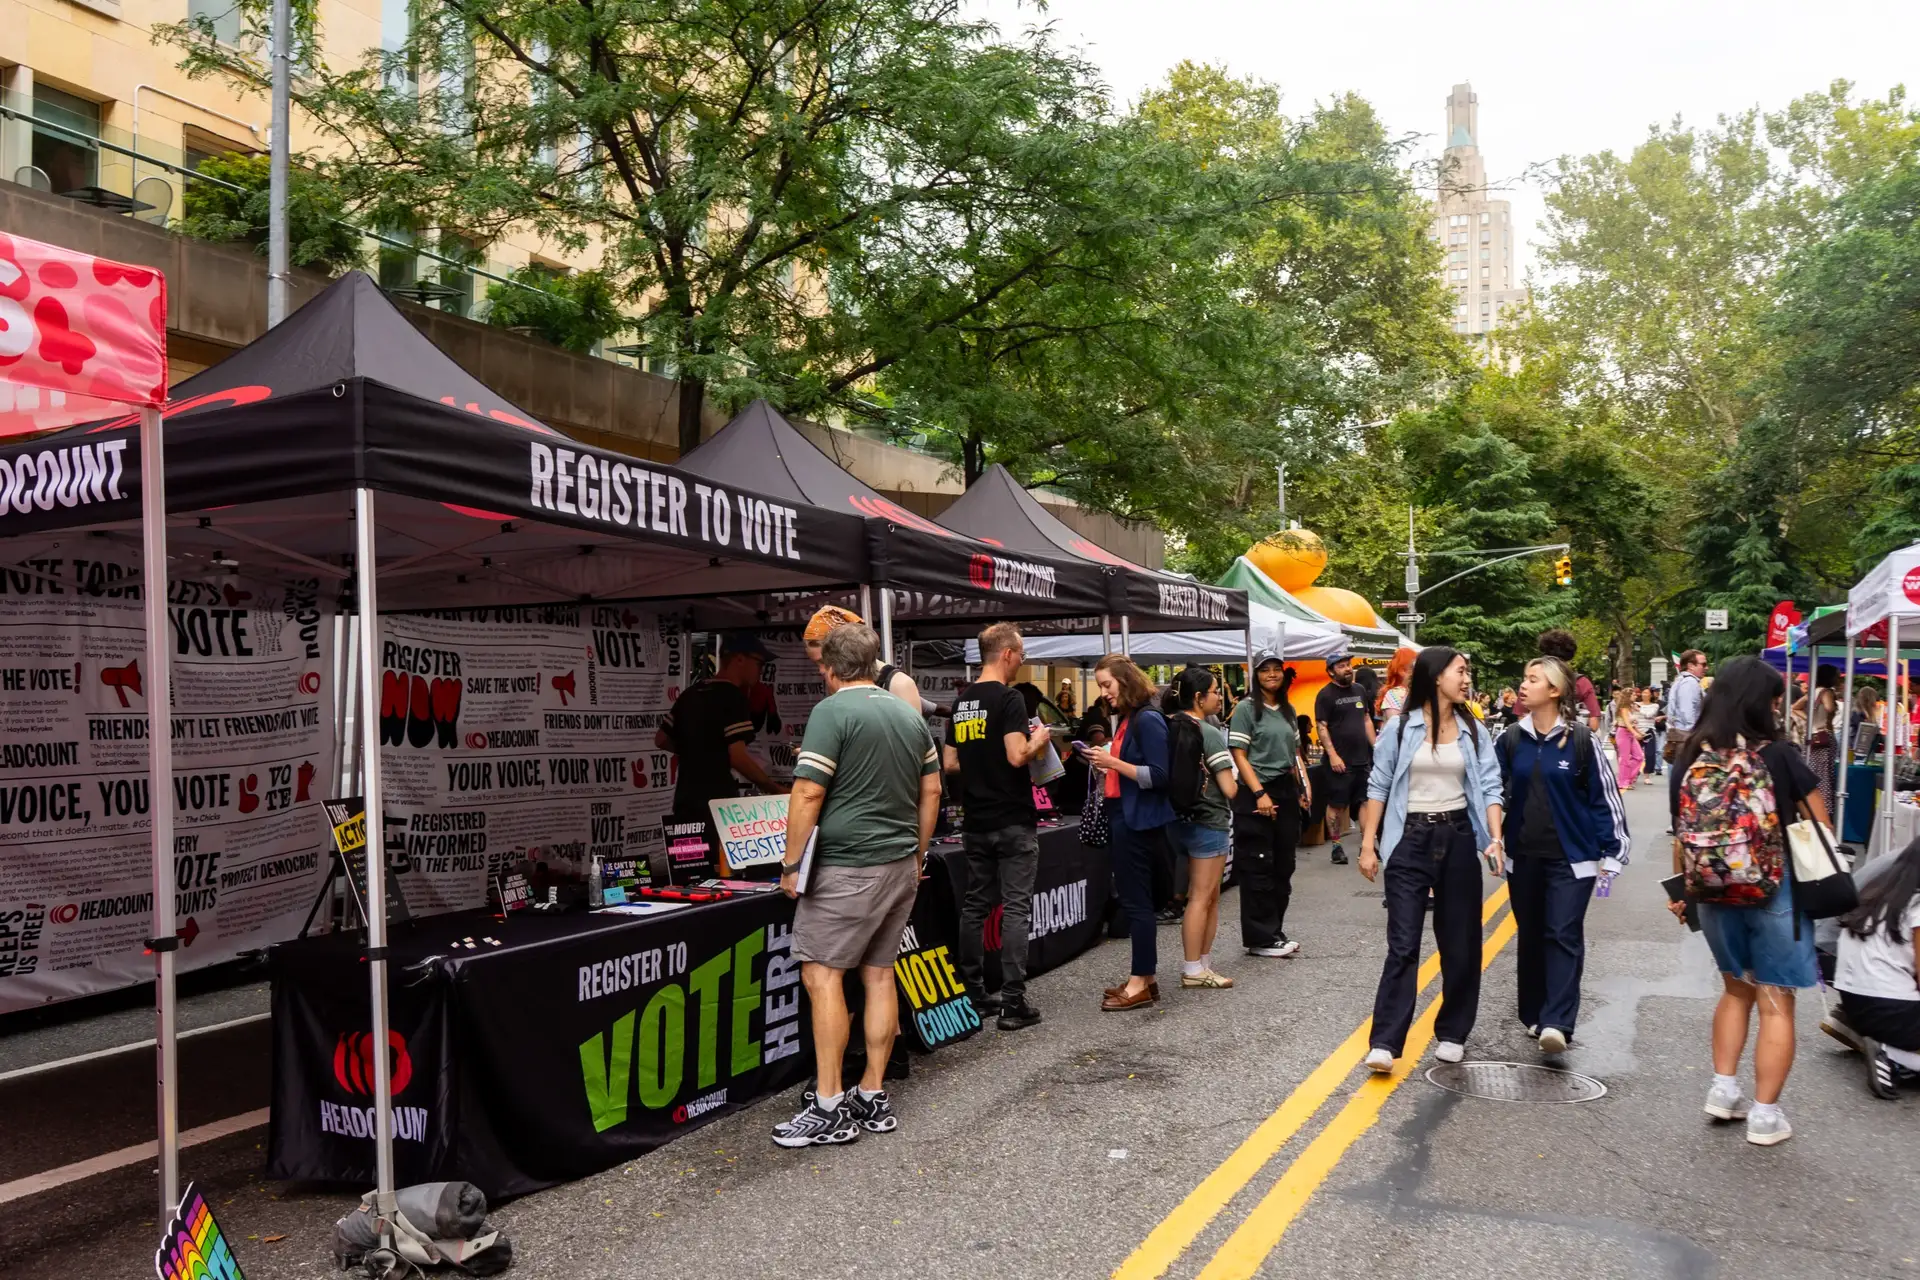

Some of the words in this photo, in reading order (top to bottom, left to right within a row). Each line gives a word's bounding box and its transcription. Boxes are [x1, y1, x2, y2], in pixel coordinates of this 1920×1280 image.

[531, 441, 688, 538] REGISTER
[695, 483, 730, 546] TO
[738, 494, 801, 560] VOTE
[993, 556, 1056, 599] HEADCOUNT
[168, 580, 221, 605] LET'S
[1158, 583, 1198, 617] REGISTER
[1199, 588, 1209, 619] TO
[1209, 591, 1229, 621] VOTE
[592, 607, 621, 629] LET'S
[168, 608, 252, 656] VOTE
[382, 640, 462, 677] REGISTER
[593, 630, 646, 667] VOTE
[0, 668, 26, 691] HE
[467, 678, 492, 694] SAVE
[494, 678, 510, 694] THE
[588, 661, 598, 706] HEADCOUNT
[380, 669, 462, 749] NOW
[957, 700, 970, 712] ARE
[970, 699, 980, 711] YOU
[980, 709, 988, 720] TO
[199, 719, 220, 738] LET
[543, 714, 581, 730] FRIENDS
[584, 714, 609, 730] DON'T
[487, 729, 540, 749] HEADCOUNT
[447, 762, 492, 791] YOUR
[497, 758, 545, 790] VOICE,
[549, 758, 588, 785] YOUR
[593, 757, 627, 784] VOTE
[0, 783, 90, 826] VOICE,
[173, 774, 231, 811] VOTE
[327, 803, 349, 824] TAKE
[590, 802, 612, 816] EVERY
[718, 803, 757, 826] NEW
[757, 800, 788, 821] YOR
[32, 827, 54, 837] that
[55, 826, 63, 835] it
[65, 823, 98, 835] doesn't
[100, 822, 129, 831] matter.
[185, 815, 199, 824] The
[199, 813, 222, 822] Chicks
[410, 811, 487, 832] REGISTERED
[591, 815, 625, 844] VOTE
[674, 822, 706, 836] MOVED?
[408, 832, 488, 857] INFORMED
[260, 851, 319, 879] DEMOCRACY
[426, 856, 449, 873] THE
[451, 853, 486, 873] POLLS
[20, 903, 46, 951] FREE!
[14, 955, 38, 975] US
[52, 963, 69, 971] Leon
[69, 960, 93, 971] Bridges
[579, 947, 662, 1002] REGISTER
[667, 941, 687, 977] TO
[894, 945, 966, 1010] VOTE
[763, 924, 800, 1065] HERE
[579, 926, 764, 1133] VOTE
[917, 995, 980, 1046] COUNTS
[686, 1087, 728, 1120] HEADCOUNT
